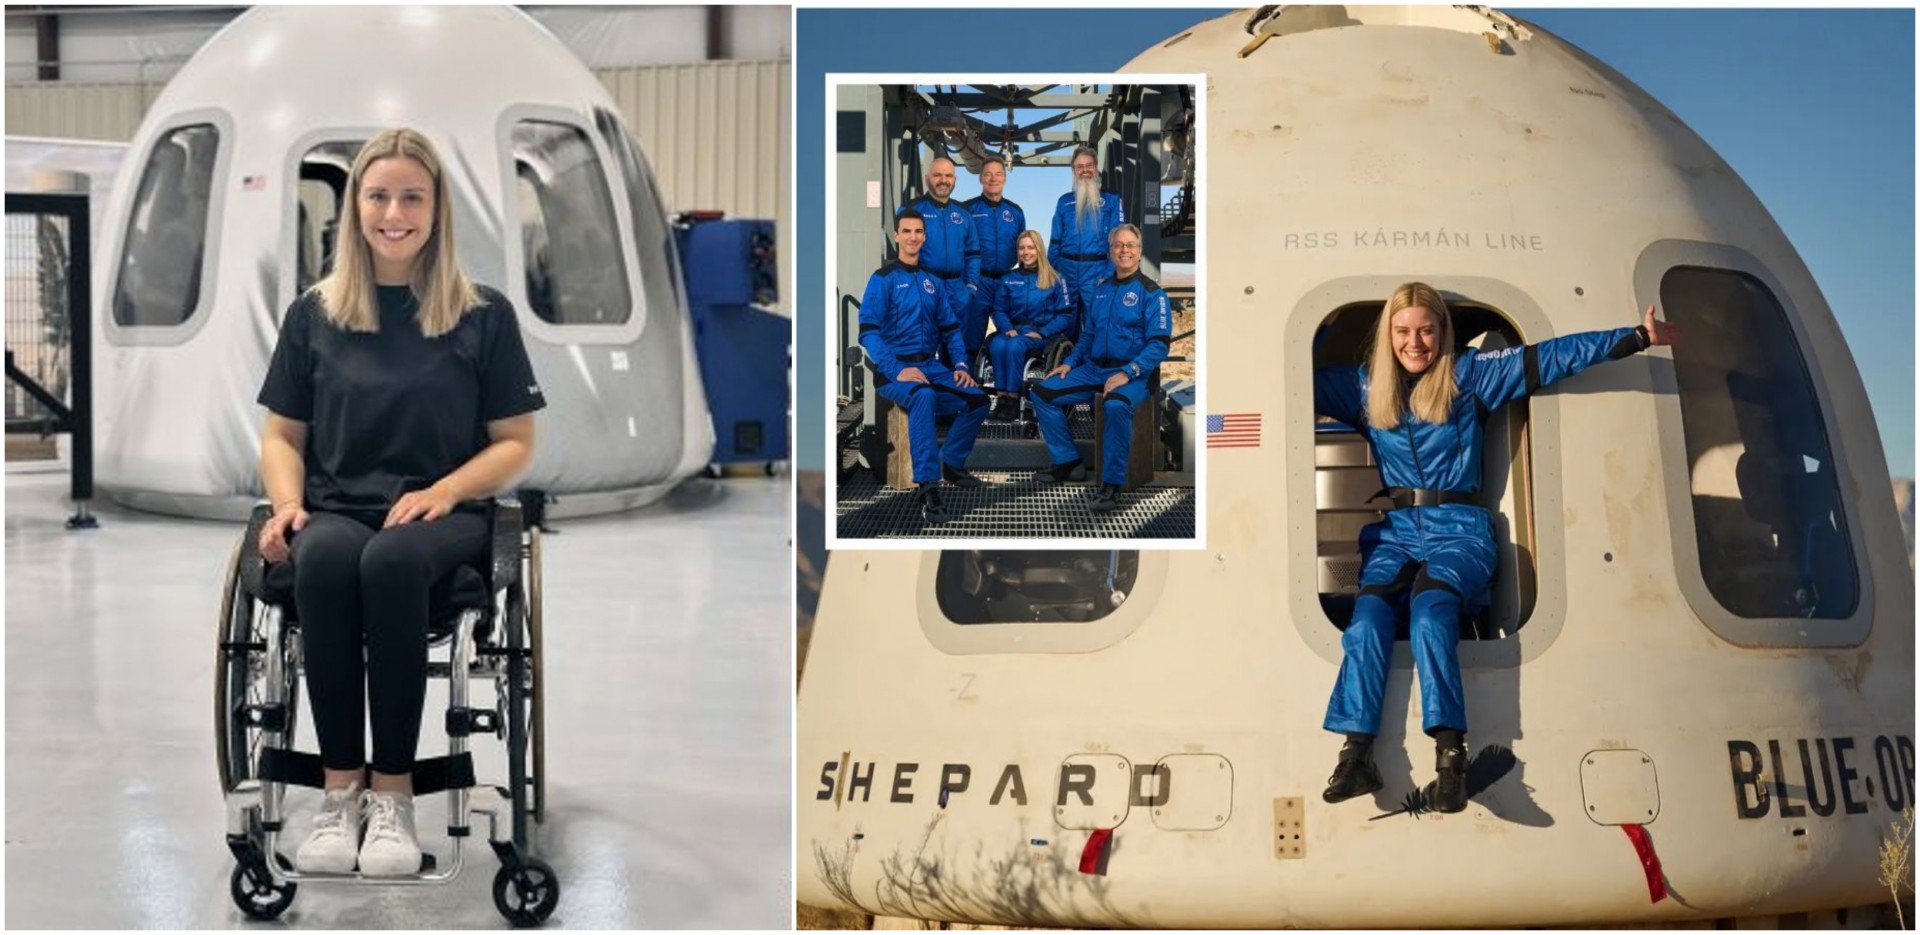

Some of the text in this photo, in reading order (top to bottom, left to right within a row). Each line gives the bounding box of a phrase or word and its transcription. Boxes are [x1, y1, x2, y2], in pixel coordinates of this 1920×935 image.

[1284, 227, 1544, 251] RSS KÁRMÁN LINE
[816, 761, 1172, 808] SHEPARD
[1727, 736, 1869, 820] BLUE
